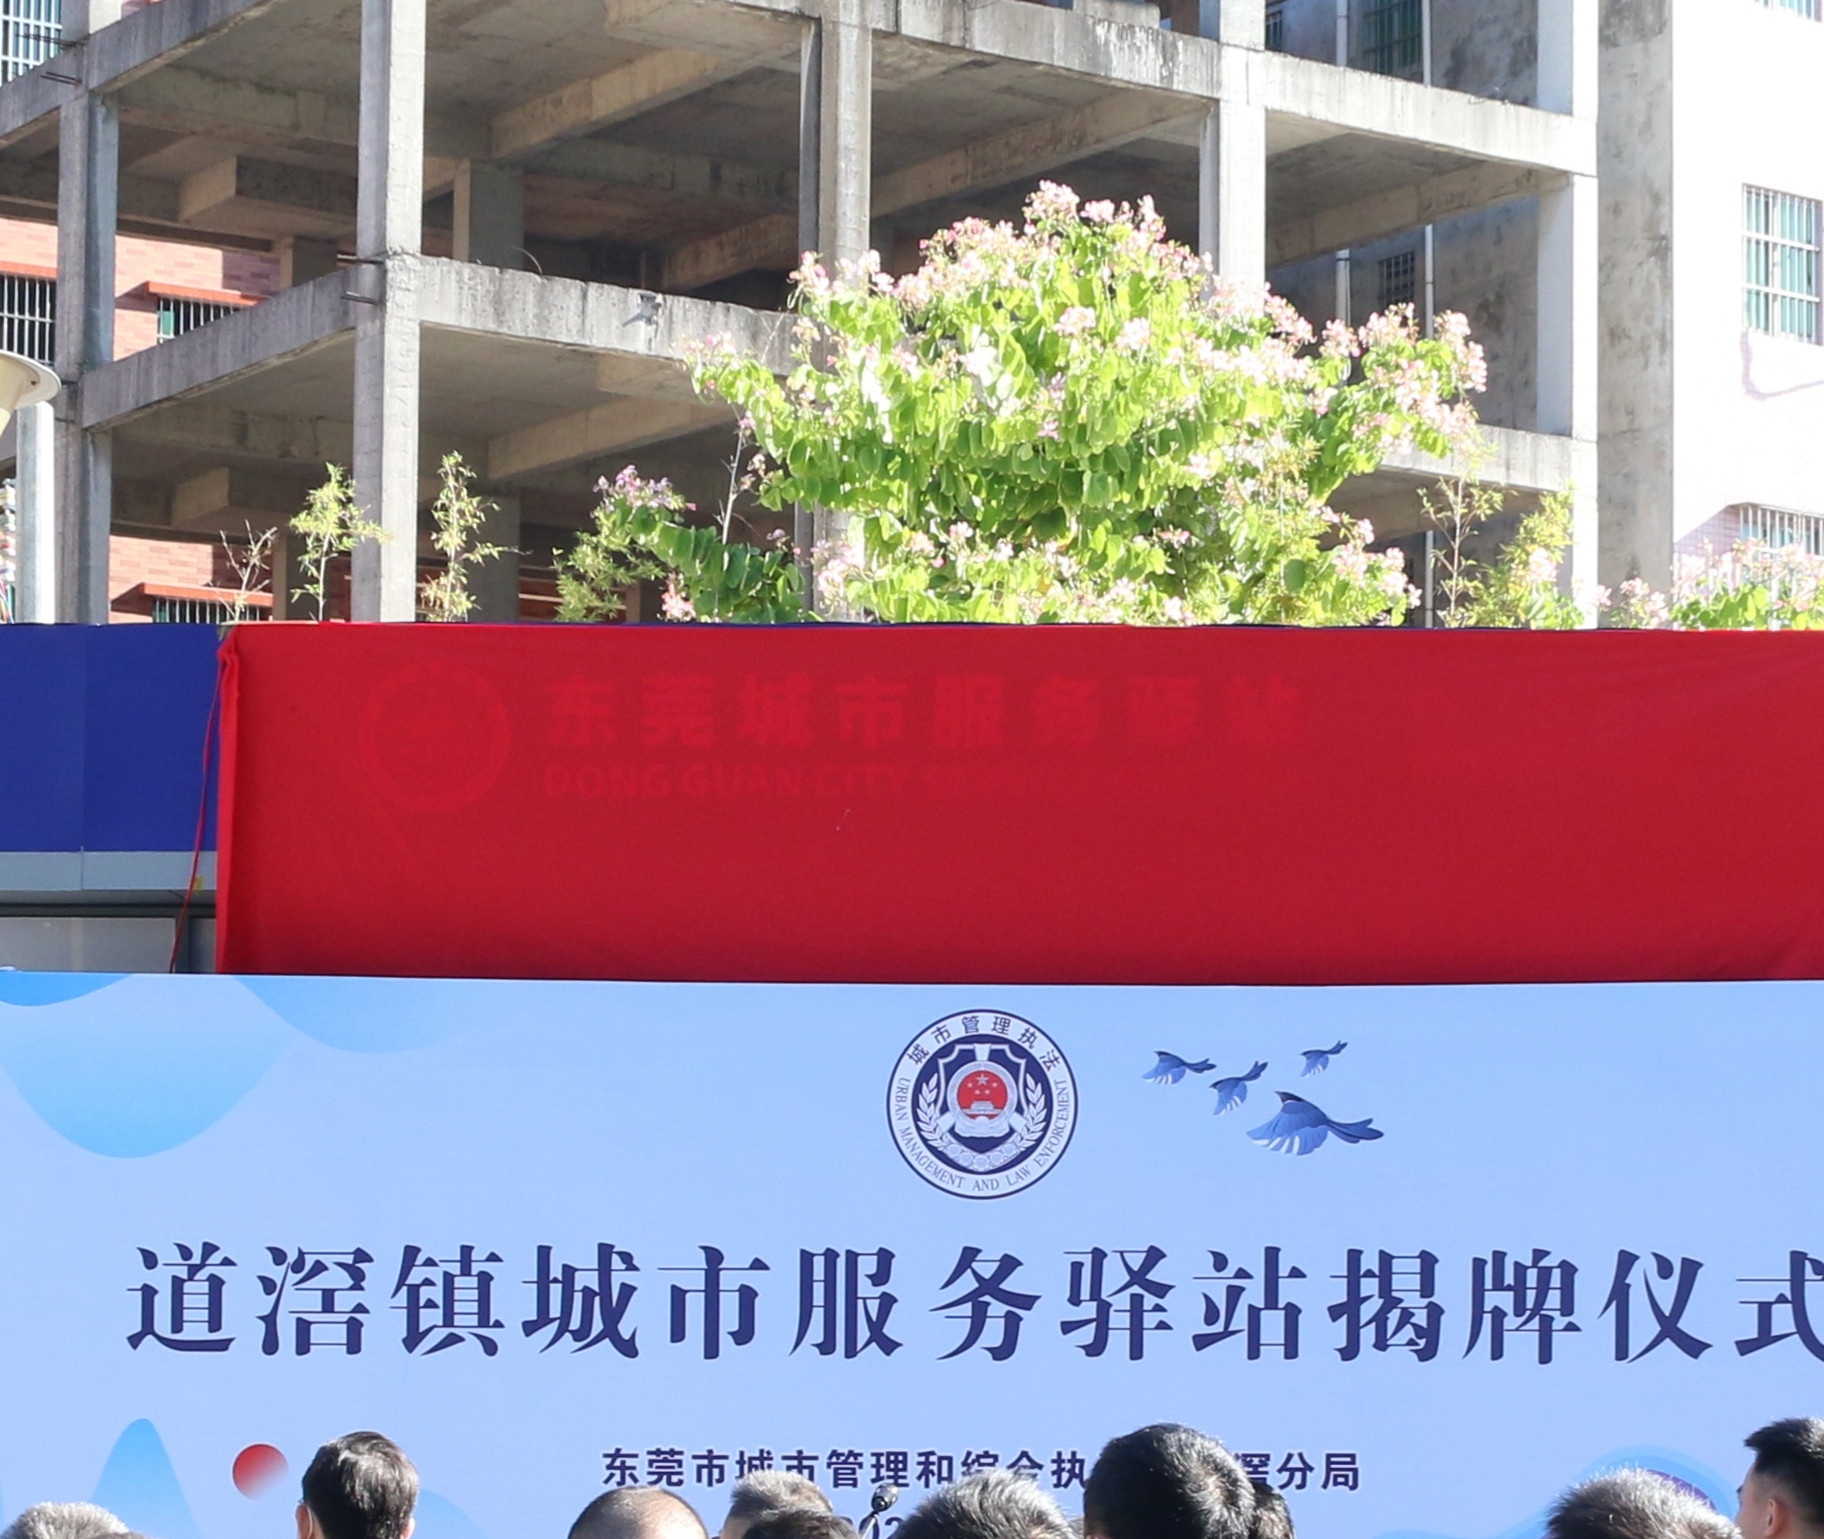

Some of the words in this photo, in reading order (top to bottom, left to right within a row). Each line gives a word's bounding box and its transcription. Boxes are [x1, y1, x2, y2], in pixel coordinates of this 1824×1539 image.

[906, 1015, 1061, 1073] 城市管理执法
[895, 1077, 911, 1121] URBAN
[1033, 1079, 1070, 1168] ENFORCEMENT
[899, 1126, 966, 1189] MANAGEMENT
[1005, 1164, 1032, 1187] LAW
[971, 1178, 1000, 1192] AND
